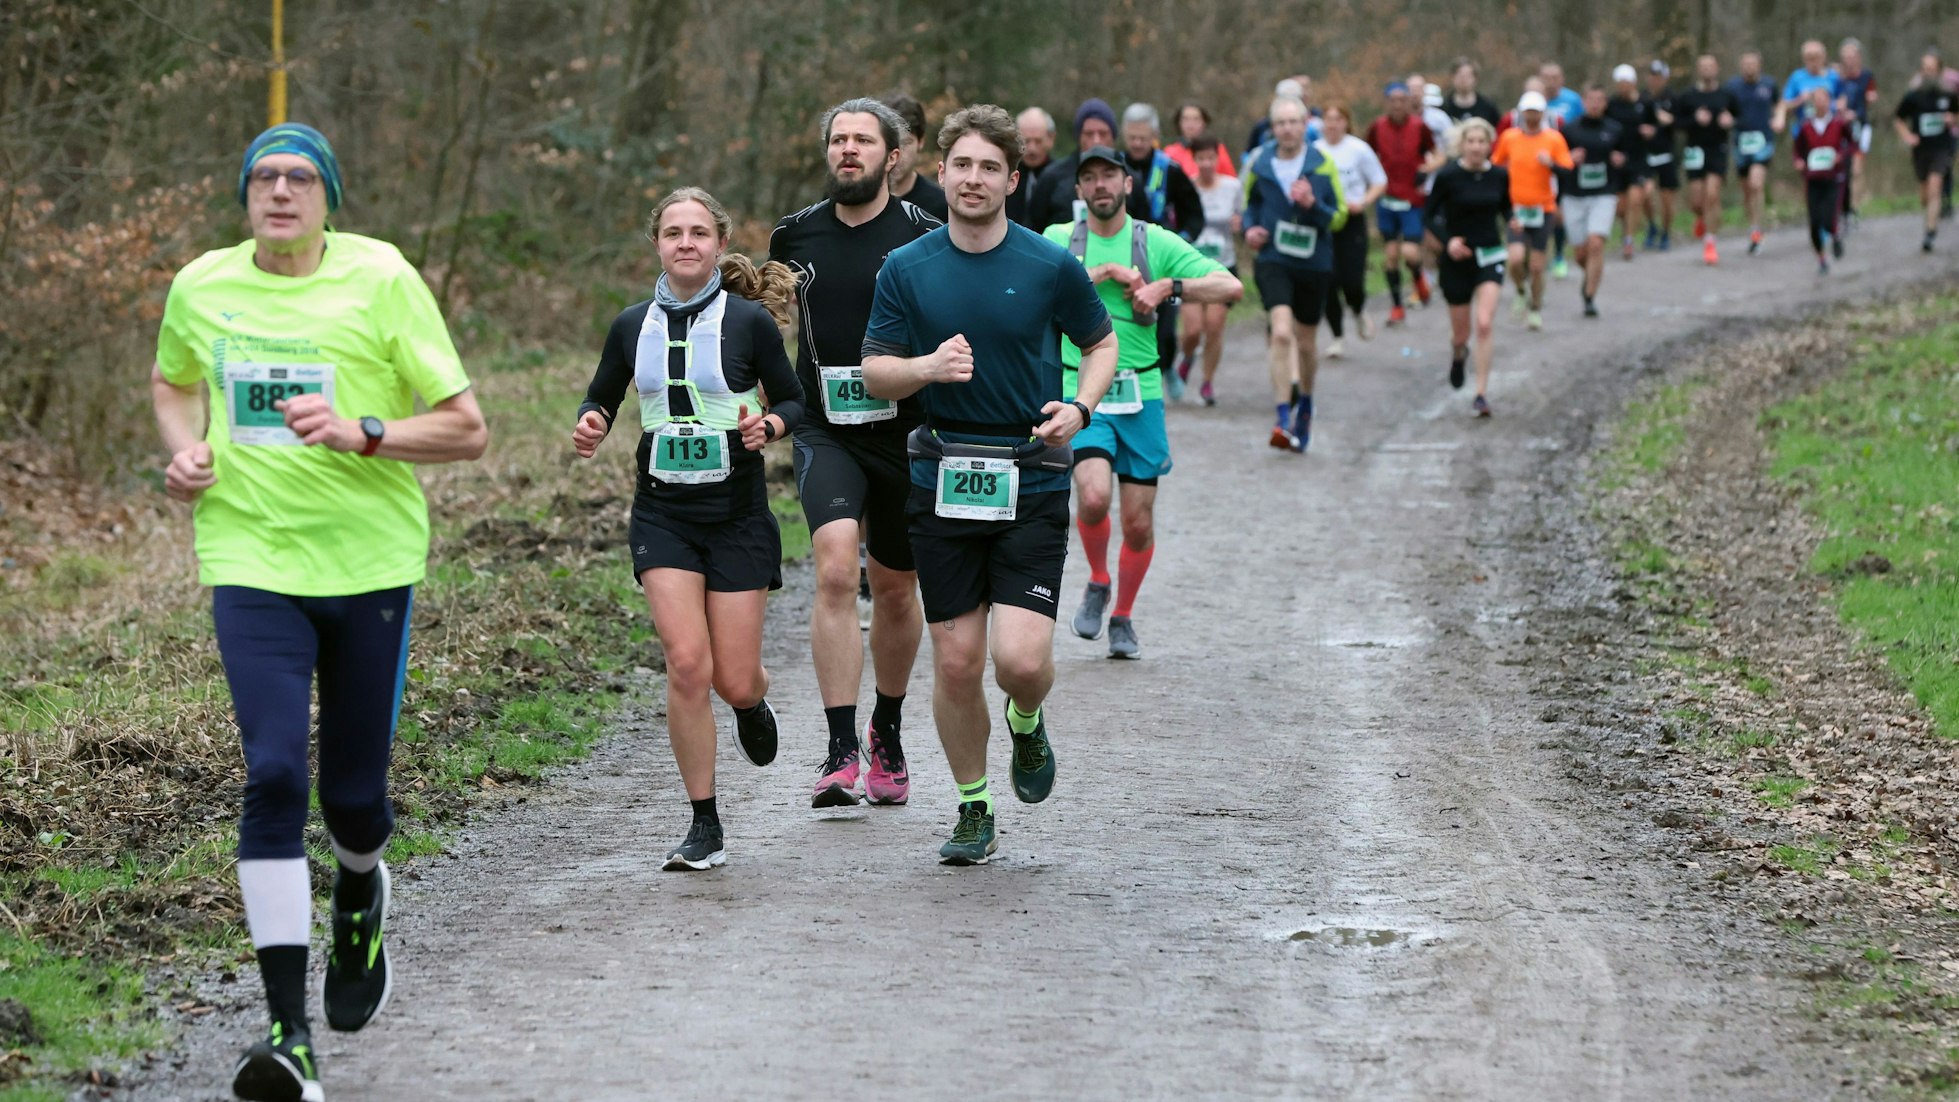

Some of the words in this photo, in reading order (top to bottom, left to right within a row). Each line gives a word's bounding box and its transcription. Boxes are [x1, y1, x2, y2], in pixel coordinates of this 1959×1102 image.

[667, 438, 708, 460] 113
[953, 472, 997, 496] 203
[1032, 584, 1052, 597] JAKO
